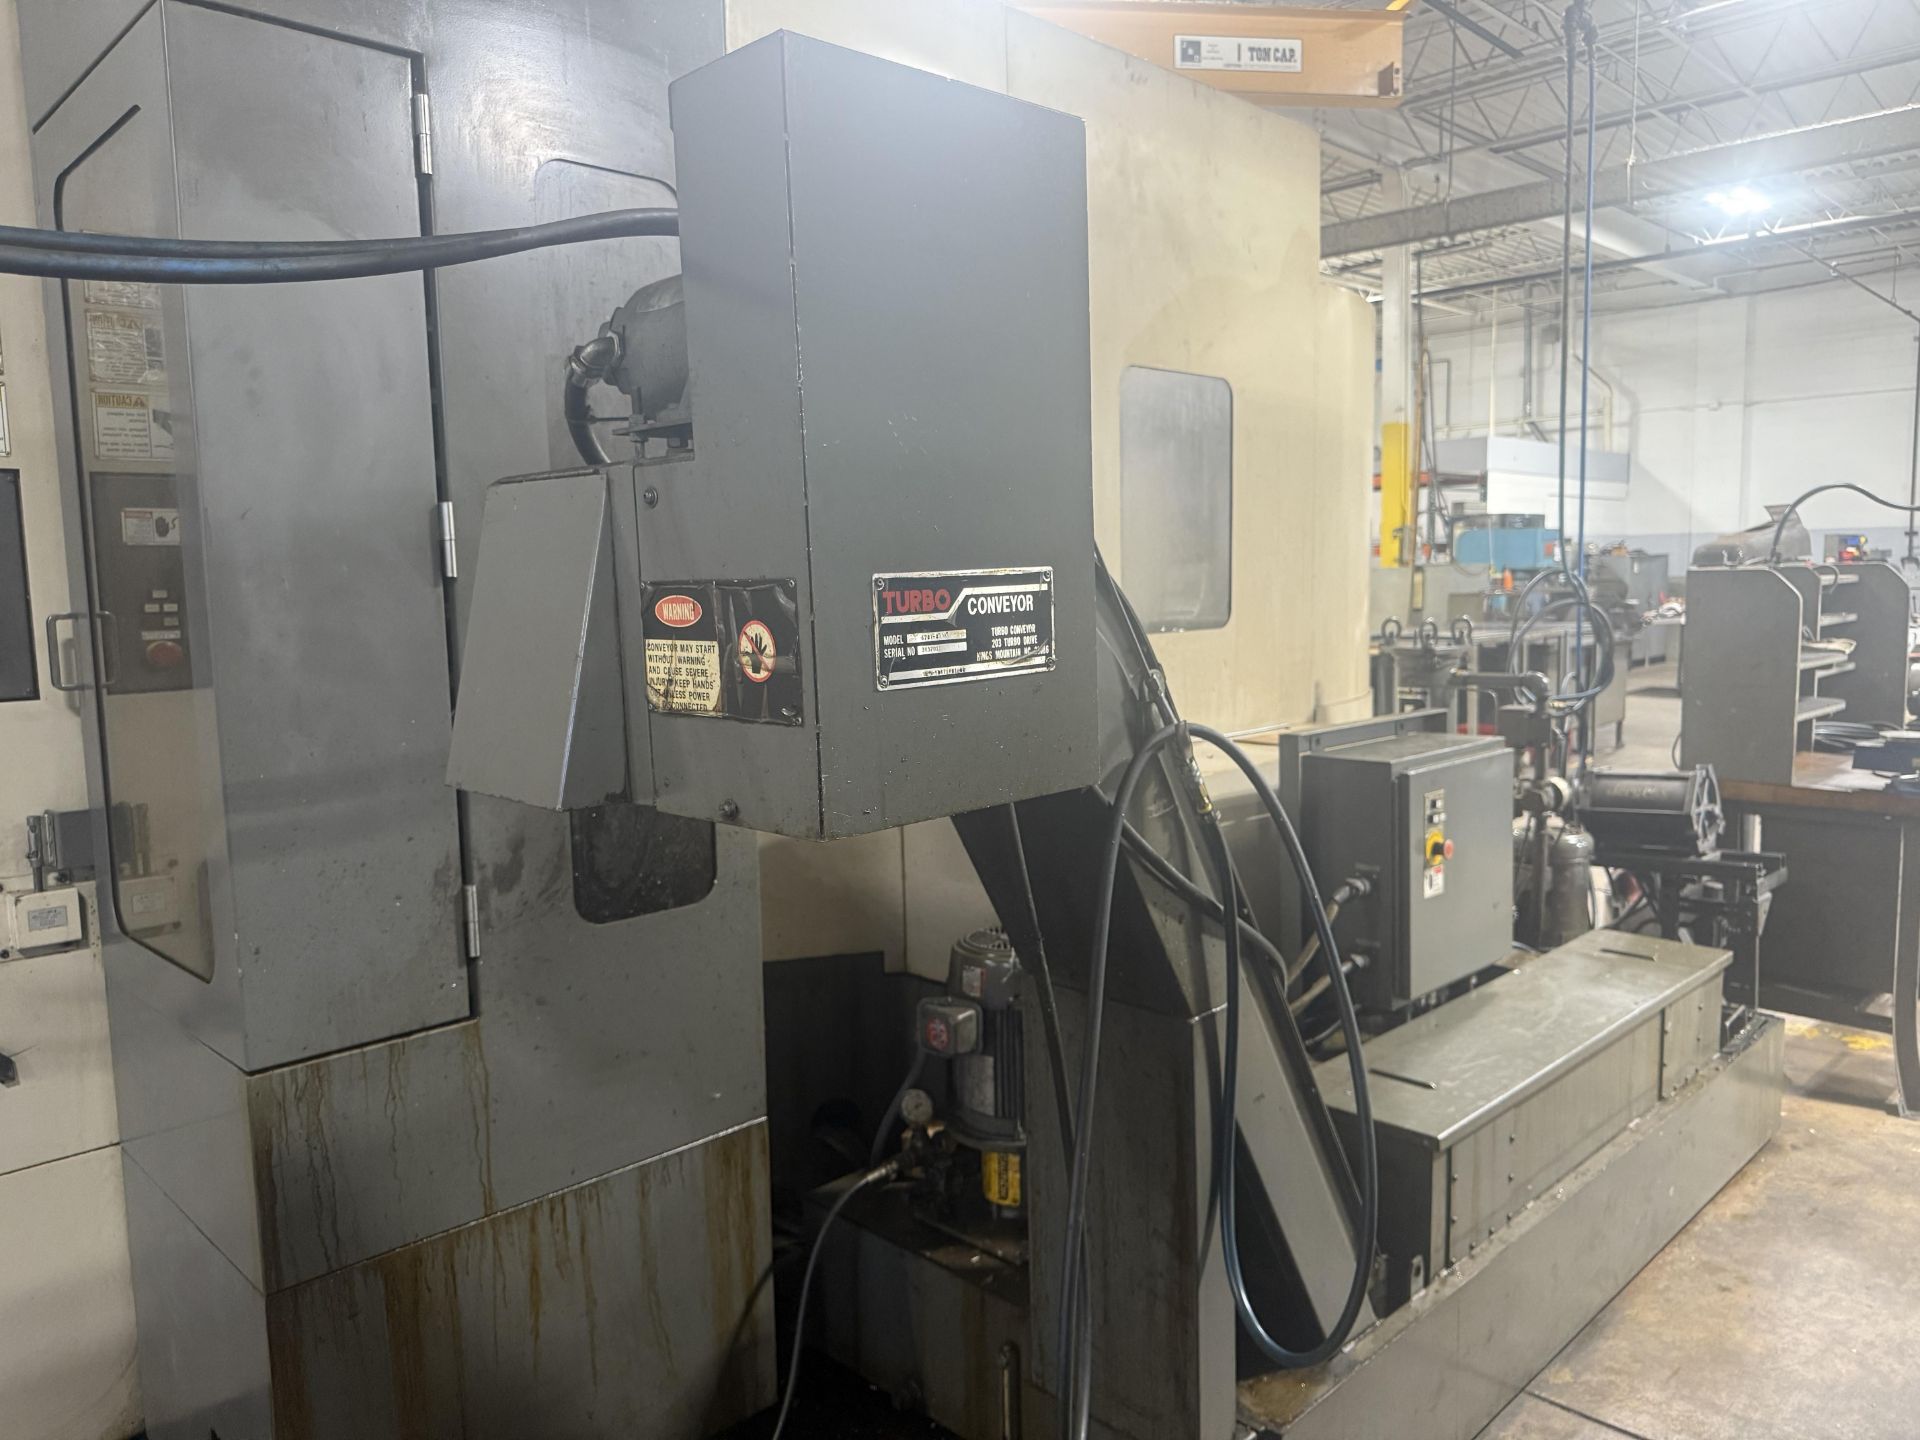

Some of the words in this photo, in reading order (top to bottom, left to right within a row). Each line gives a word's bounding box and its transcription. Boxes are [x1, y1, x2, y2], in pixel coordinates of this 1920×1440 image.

[1248, 47, 1271, 62] TON
[882, 588, 951, 614] TURBO
[967, 594, 1034, 616] CONVEYOR
[662, 603, 695, 621] WARNING
[991, 625, 1008, 637] TURBO
[1010, 624, 1036, 635] CONVEYOR
[883, 634, 904, 646] MODEL
[991, 638, 1002, 648] 203
[1004, 636, 1021, 647] TURBO
[1023, 635, 1038, 646] DRIVE
[647, 642, 677, 653] CONVEYOR
[680, 644, 693, 653] MAY
[696, 645, 715, 654] START
[883, 646, 905, 659] SERIAL
[907, 646, 916, 657] NO
[976, 651, 992, 662] KINGS
[995, 647, 1021, 660] MOUNTAIN
[648, 655, 673, 665] WITHOUT
[678, 656, 706, 666] WARNING
[648, 666, 661, 675] AND
[663, 667, 684, 677] CAUSE
[685, 668, 708, 677] SEVERE
[674, 679, 690, 689] KEEP
[693, 681, 714, 690] HANDS
[688, 691, 711, 701] POWER
